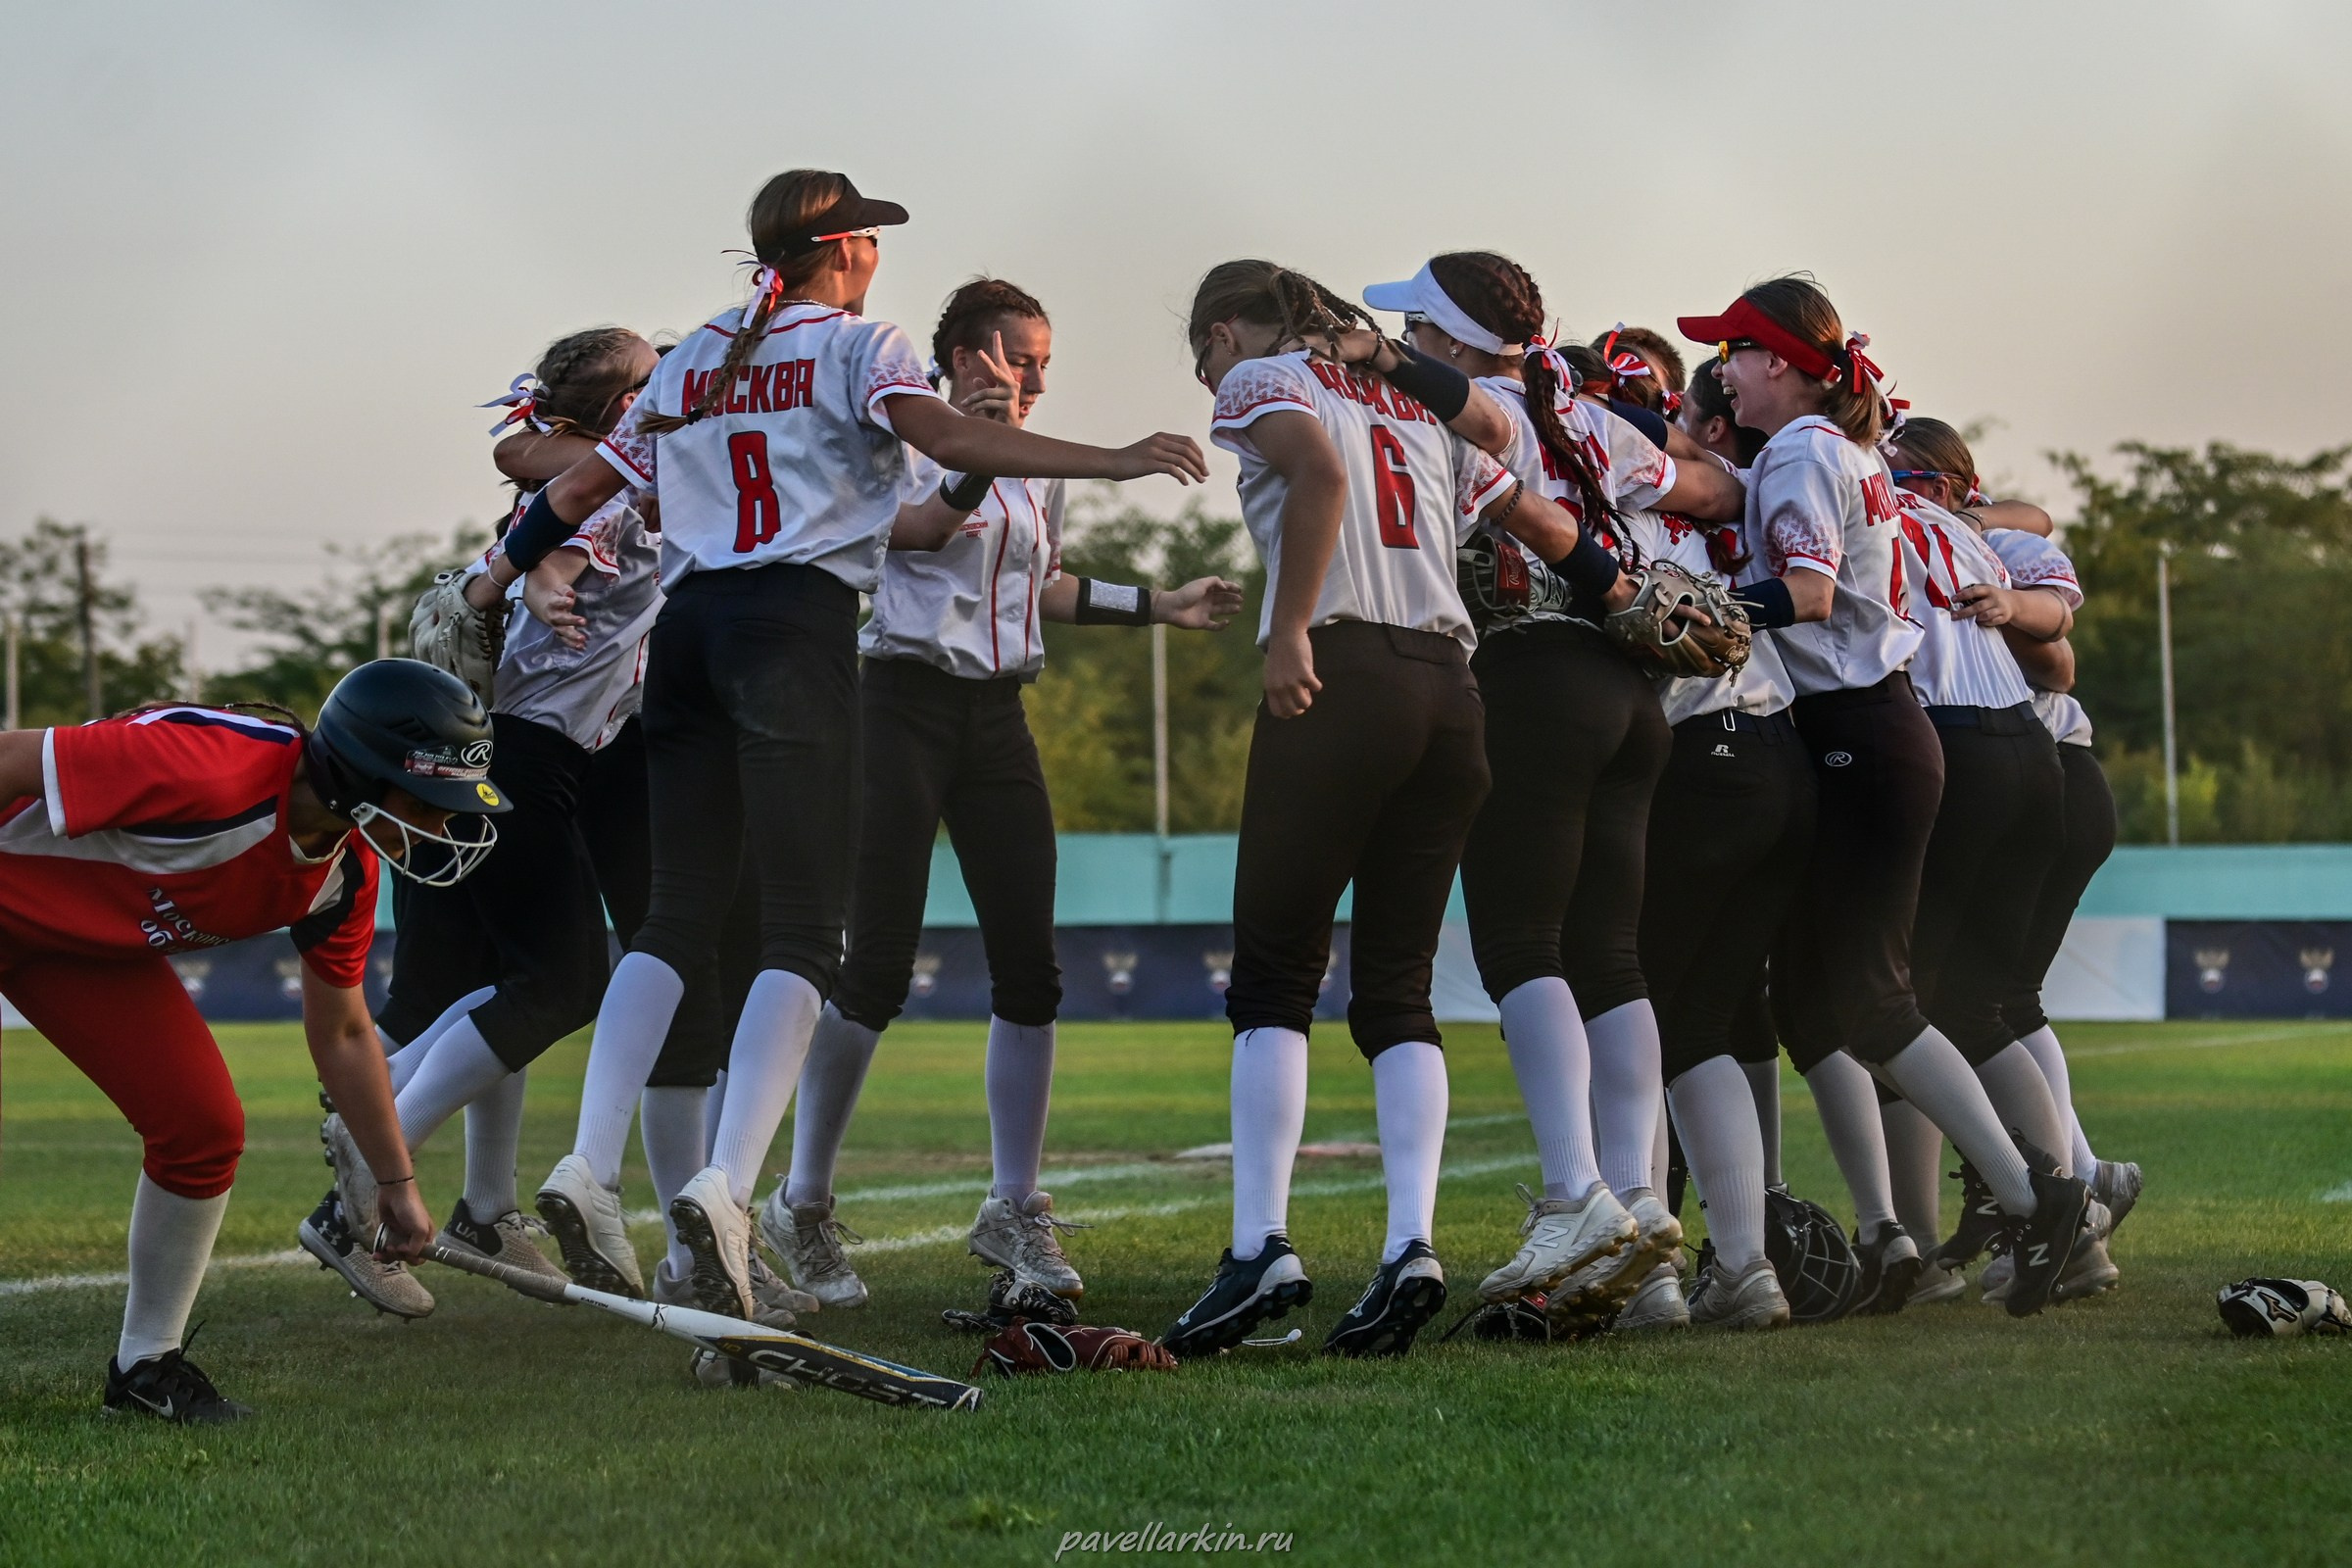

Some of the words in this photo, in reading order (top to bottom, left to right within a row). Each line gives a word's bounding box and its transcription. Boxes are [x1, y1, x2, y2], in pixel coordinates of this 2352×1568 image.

[728, 430, 781, 553] 8
[1370, 424, 1420, 549] 6
[456, 1221, 478, 1244] UA
[2028, 1243, 2050, 1267] N
[580, 1297, 610, 1308] EASTON
